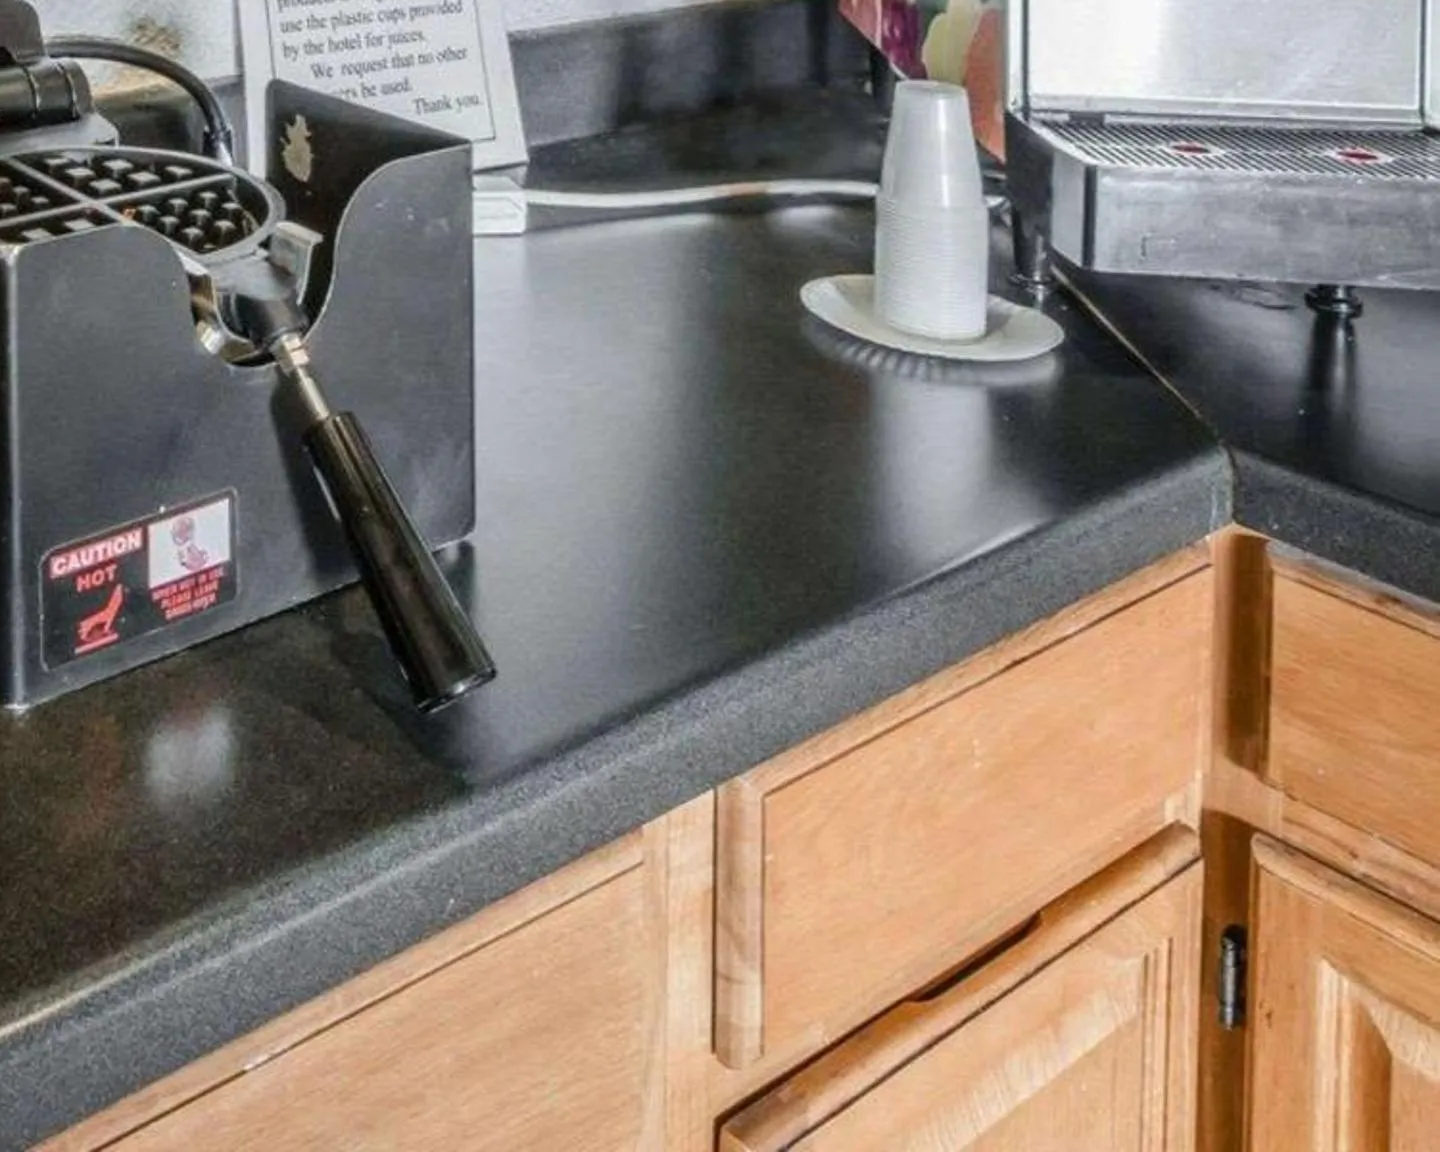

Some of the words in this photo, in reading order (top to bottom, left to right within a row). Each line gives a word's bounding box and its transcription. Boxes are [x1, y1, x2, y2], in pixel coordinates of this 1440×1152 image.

[280, 19, 302, 34] use
[306, 13, 328, 29] the
[329, 9, 374, 32] plastic
[377, 8, 407, 25] cups
[281, 40, 298, 62] by
[303, 38, 325, 55] the
[327, 33, 362, 52] hotel
[364, 32, 383, 48] for
[310, 61, 334, 79] We
[340, 57, 388, 79] request
[392, 53, 415, 70] that
[360, 82, 377, 99] be
[412, 95, 453, 116] Thank
[52, 528, 143, 576] CAUTION
[76, 564, 117, 593] HOT
